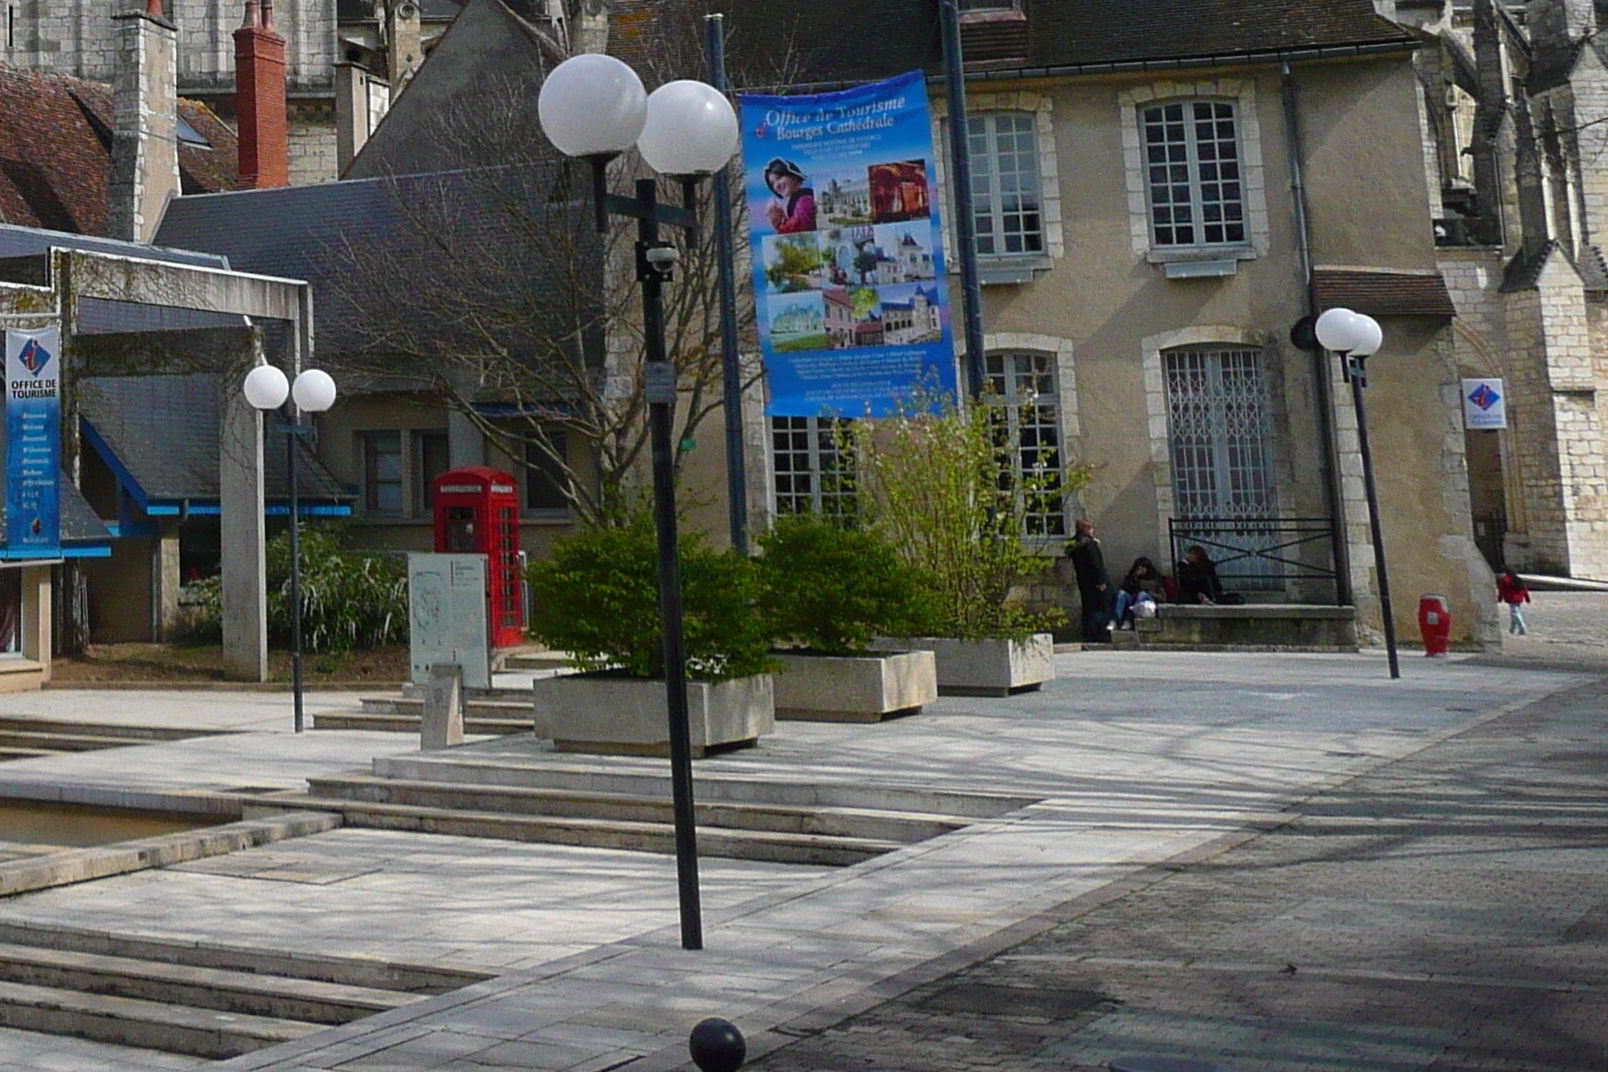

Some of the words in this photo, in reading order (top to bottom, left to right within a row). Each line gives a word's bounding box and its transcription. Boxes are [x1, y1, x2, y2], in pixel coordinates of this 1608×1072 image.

[766, 108, 811, 127] Office
[815, 107, 833, 123] de
[836, 96, 905, 119] Tourisme
[777, 124, 823, 141] Bourges
[827, 113, 894, 134] Cathédrale
[11, 380, 44, 390] OFFICE
[45, 379, 57, 388] DE
[11, 388, 57, 399] TOURISME
